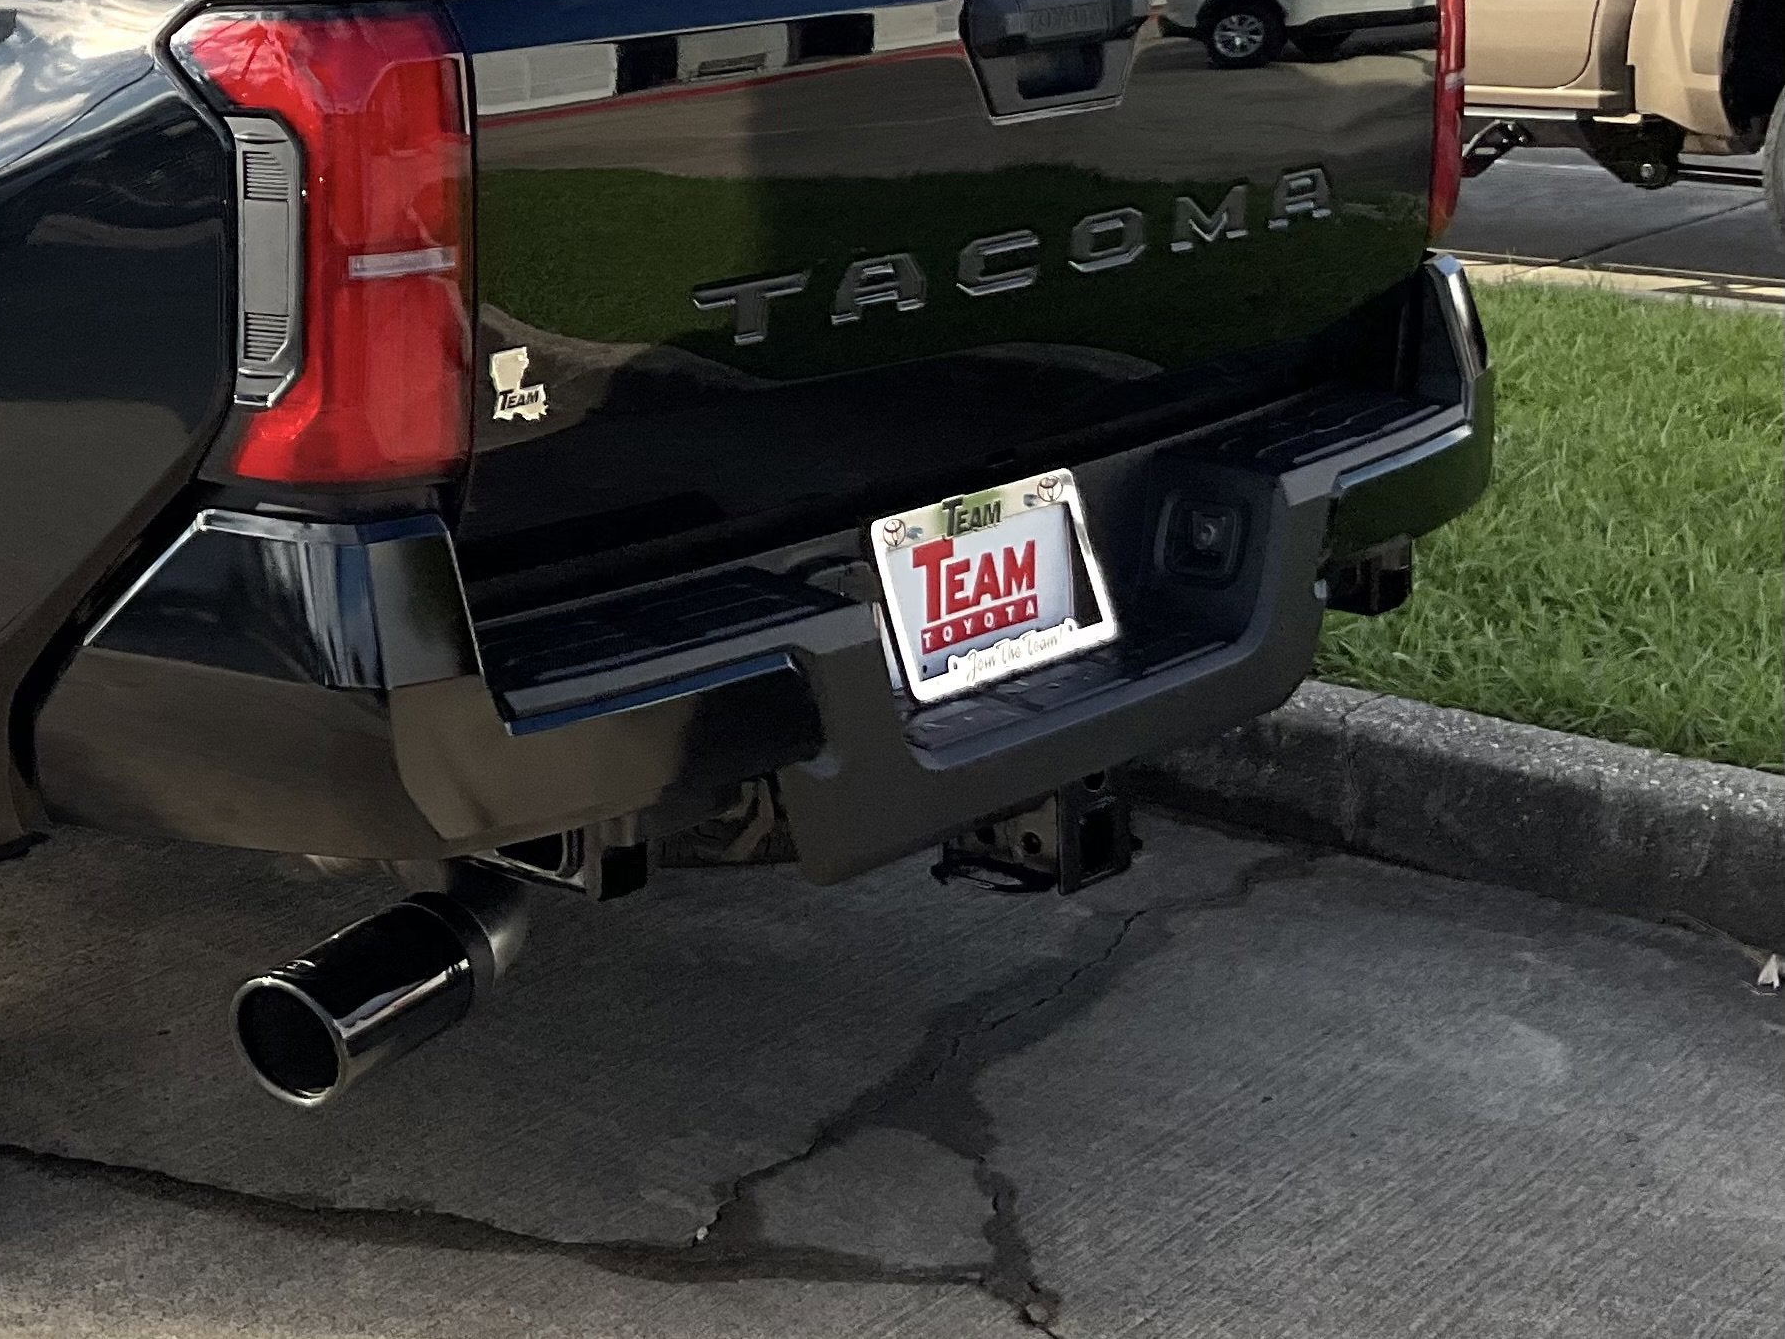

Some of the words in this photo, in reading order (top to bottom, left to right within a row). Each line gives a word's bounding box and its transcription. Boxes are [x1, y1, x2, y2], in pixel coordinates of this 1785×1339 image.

[692, 167, 1331, 344] TACOMA
[499, 389, 539, 411] TEAM
[942, 495, 1002, 537] TEAM
[912, 538, 1036, 624] TEAM
[922, 603, 1036, 648] TOYOTA
[966, 651, 996, 681] Join
